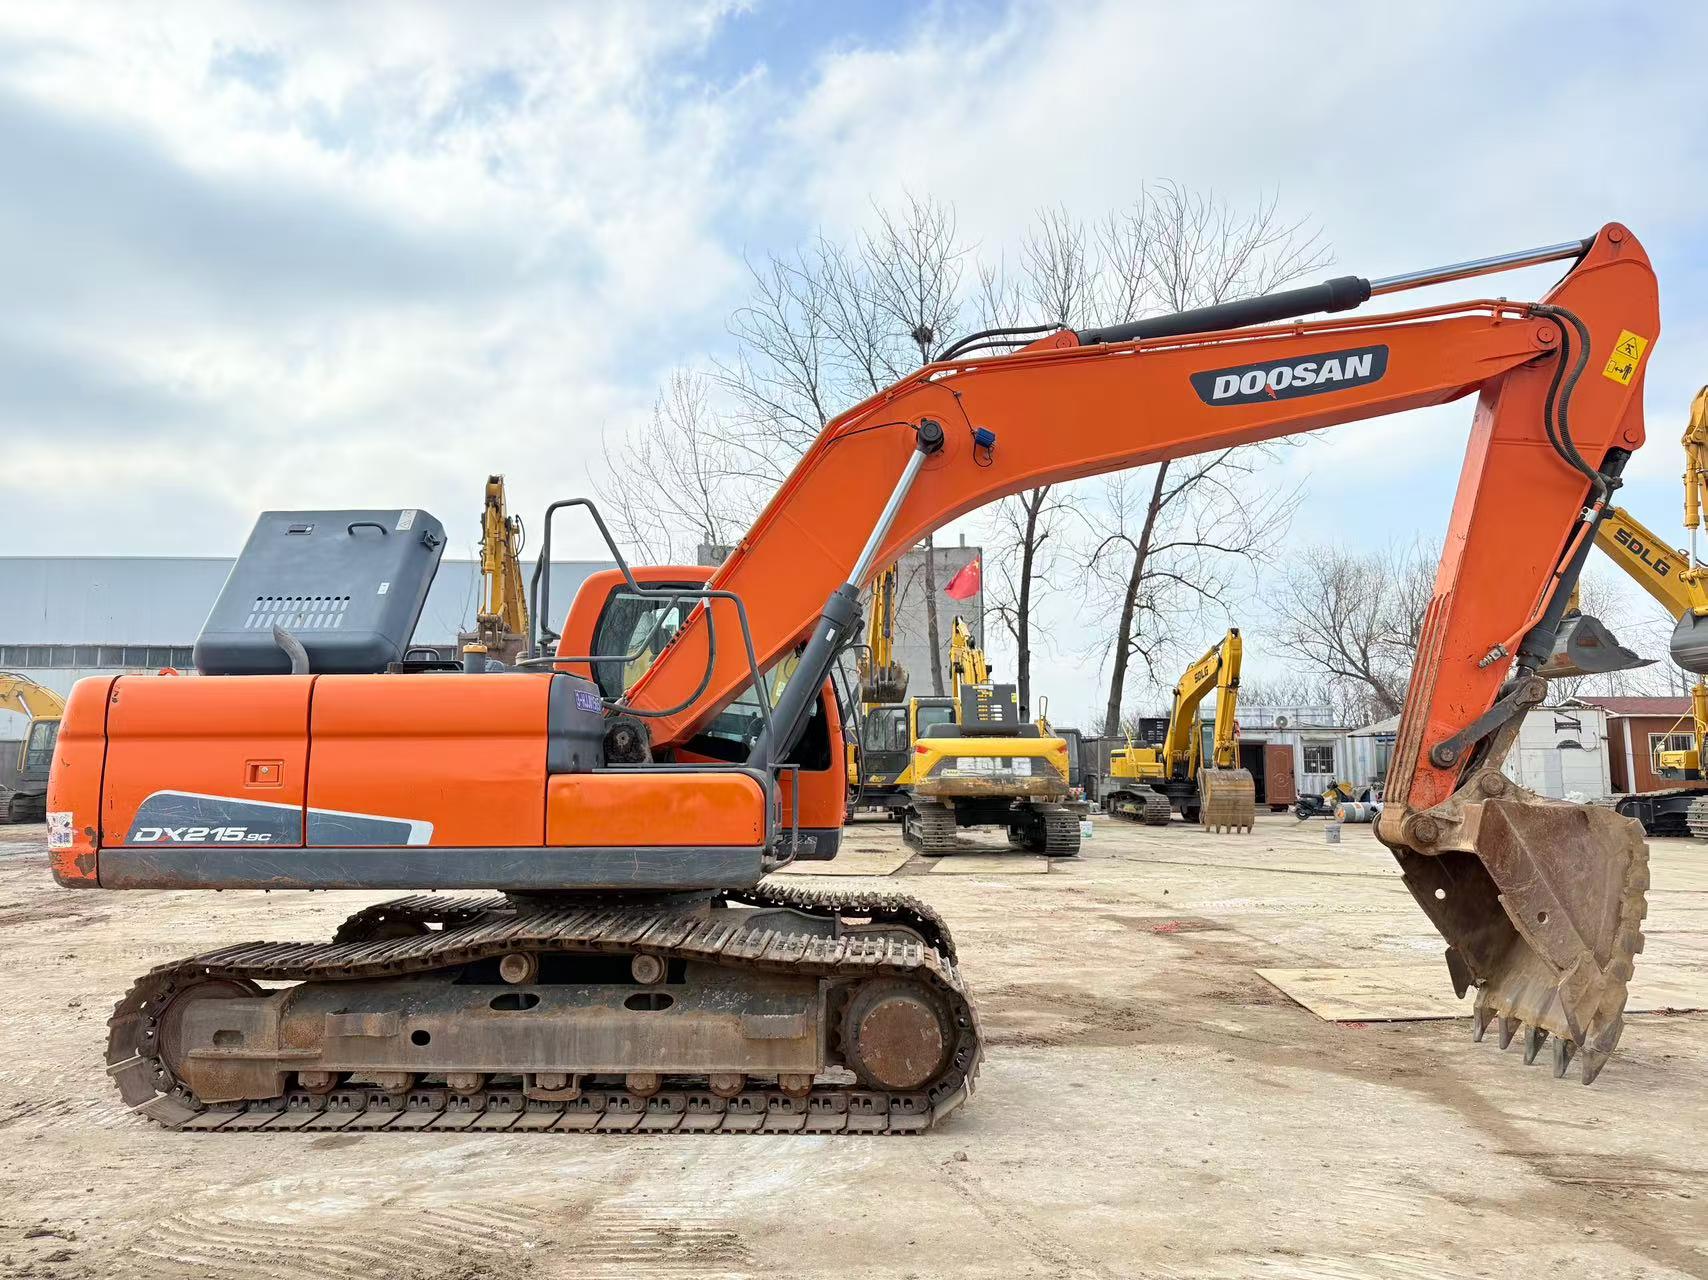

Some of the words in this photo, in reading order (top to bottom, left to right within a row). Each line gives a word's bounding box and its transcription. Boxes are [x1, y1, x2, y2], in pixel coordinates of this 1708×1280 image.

[1213, 354, 1373, 400] DOOSAN
[1613, 527, 1671, 577] SDLG
[1194, 665, 1209, 684] SDLG
